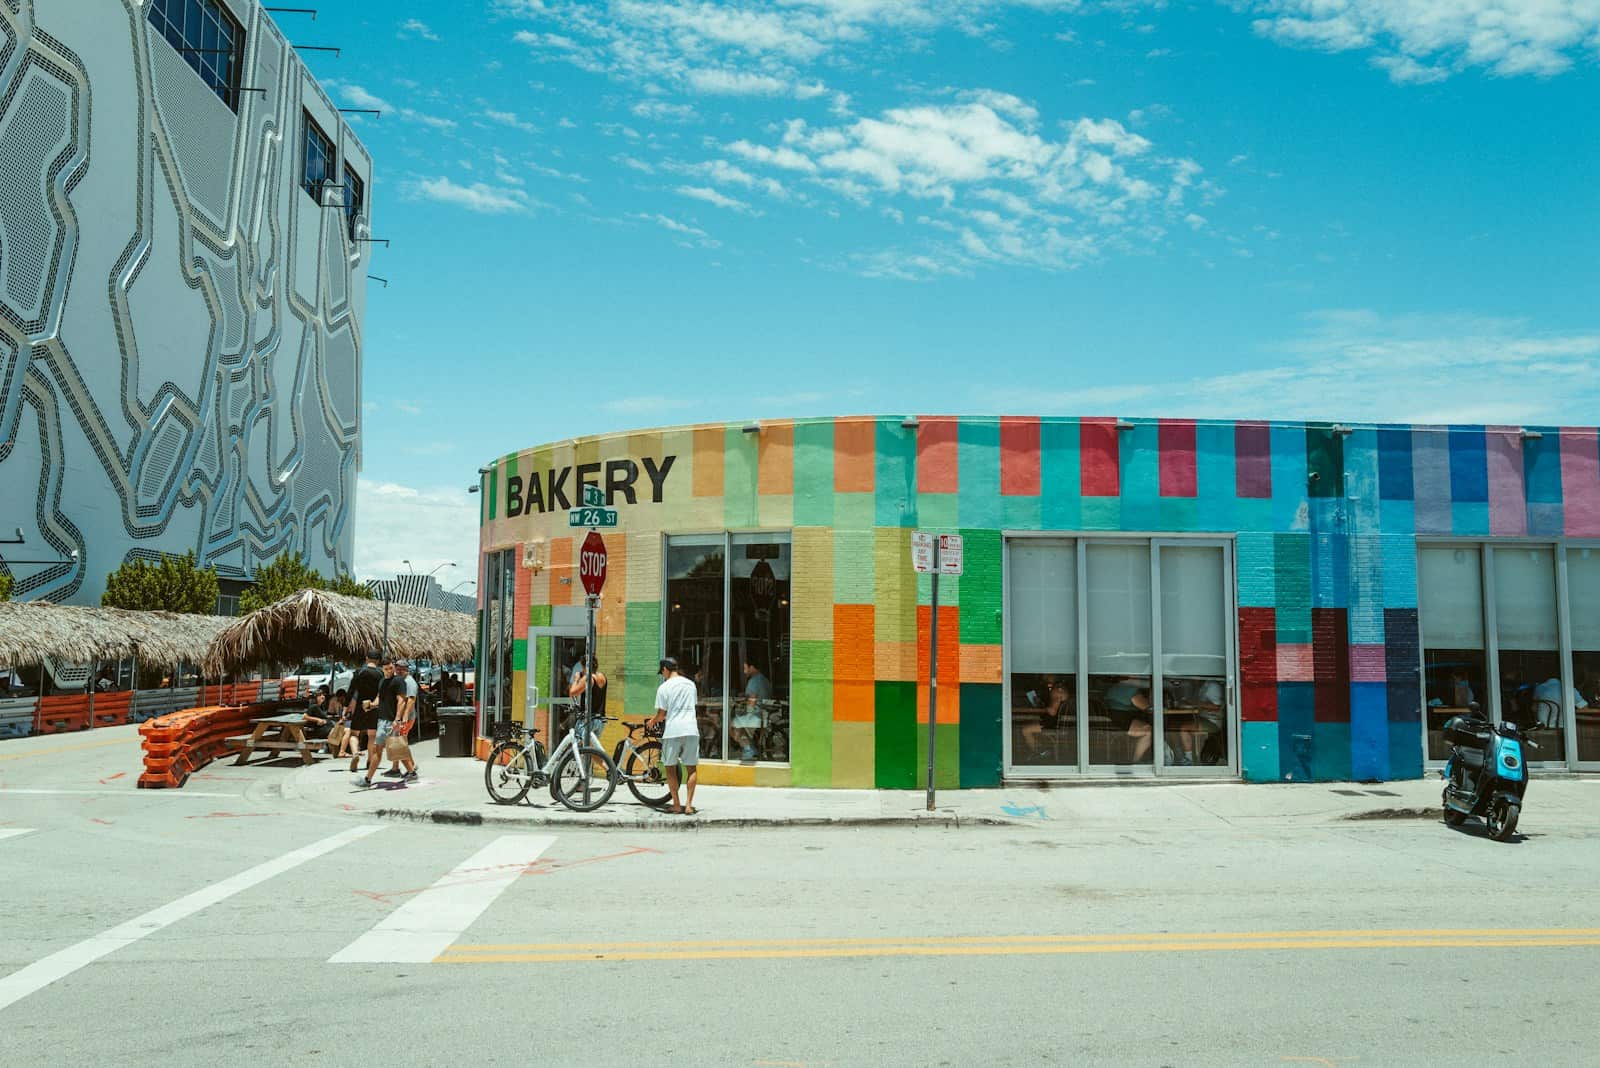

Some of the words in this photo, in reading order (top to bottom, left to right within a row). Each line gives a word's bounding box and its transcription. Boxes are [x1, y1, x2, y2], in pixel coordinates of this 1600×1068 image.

[507, 455, 676, 518] BAKERY
[570, 512, 580, 523] NW
[584, 510, 600, 525] 26
[606, 512, 616, 524] ST
[581, 551, 605, 576] STOP
